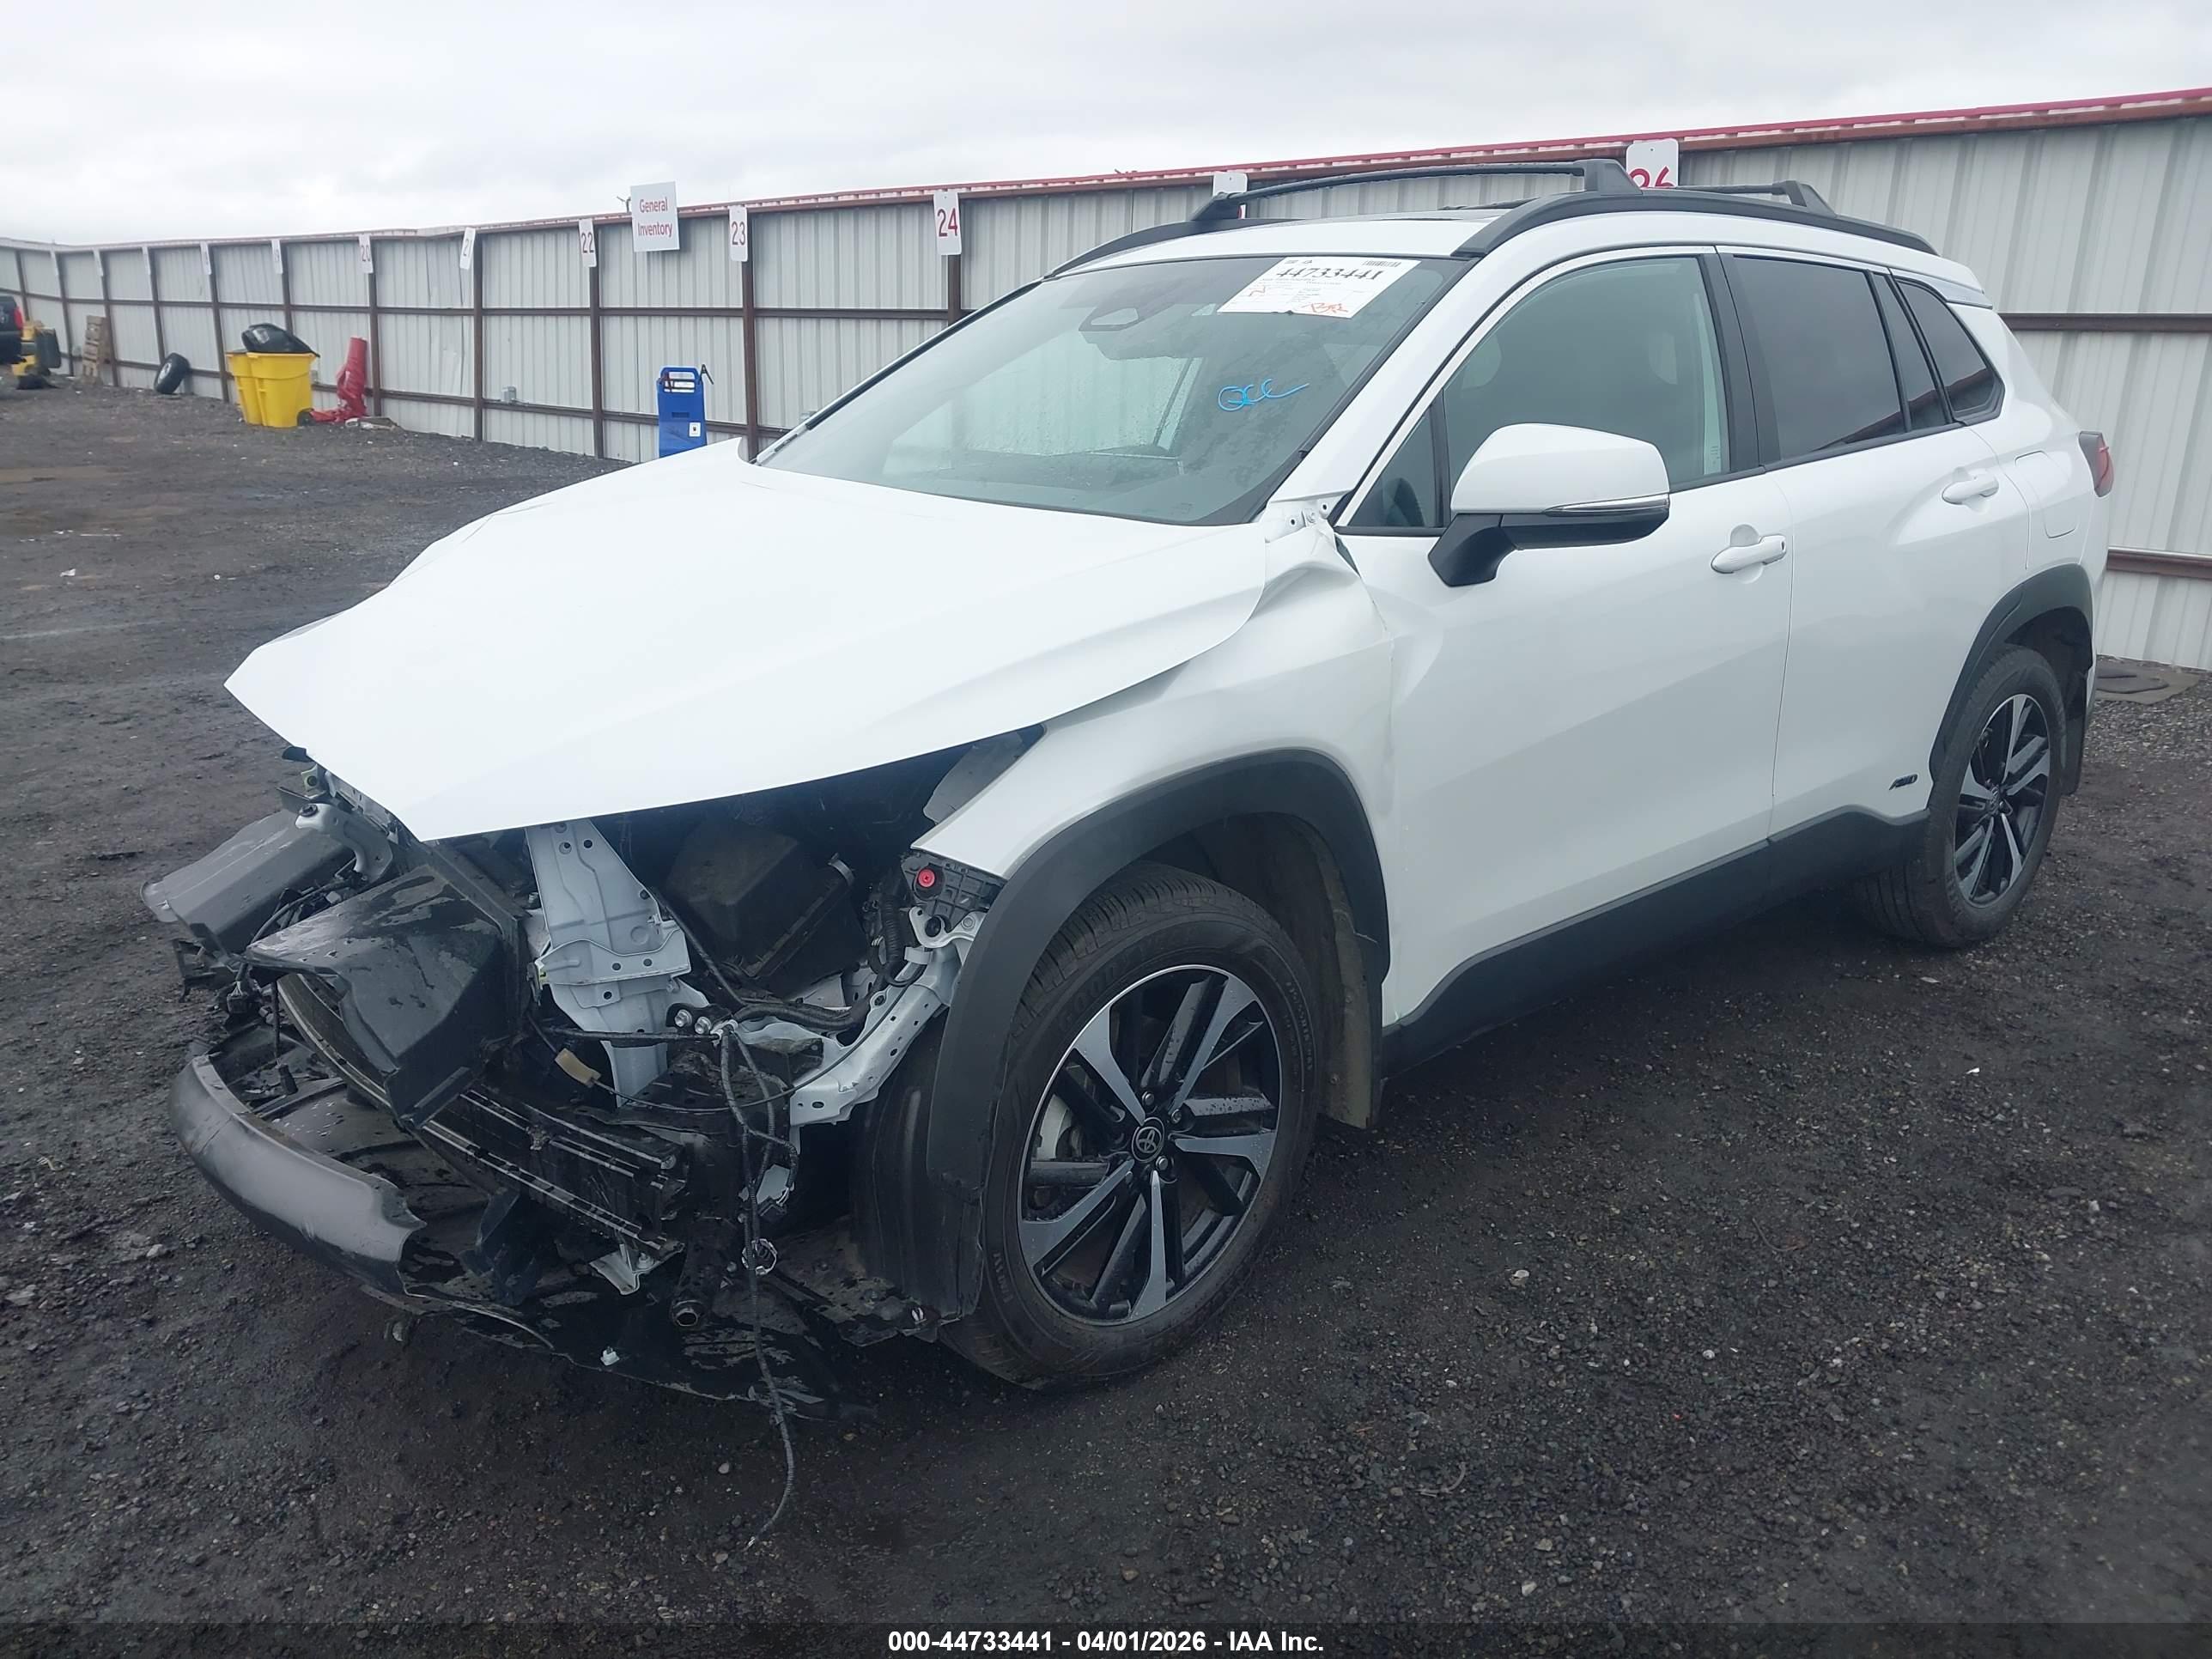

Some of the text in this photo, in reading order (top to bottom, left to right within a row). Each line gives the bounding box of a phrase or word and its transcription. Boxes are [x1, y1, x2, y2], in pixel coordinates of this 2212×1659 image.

[639, 197, 668, 213] General
[637, 222, 672, 238] Inventory
[938, 208, 958, 237] 24
[581, 232, 594, 253] 22
[732, 221, 746, 246] 23
[1276, 267, 1385, 280] 44733441
